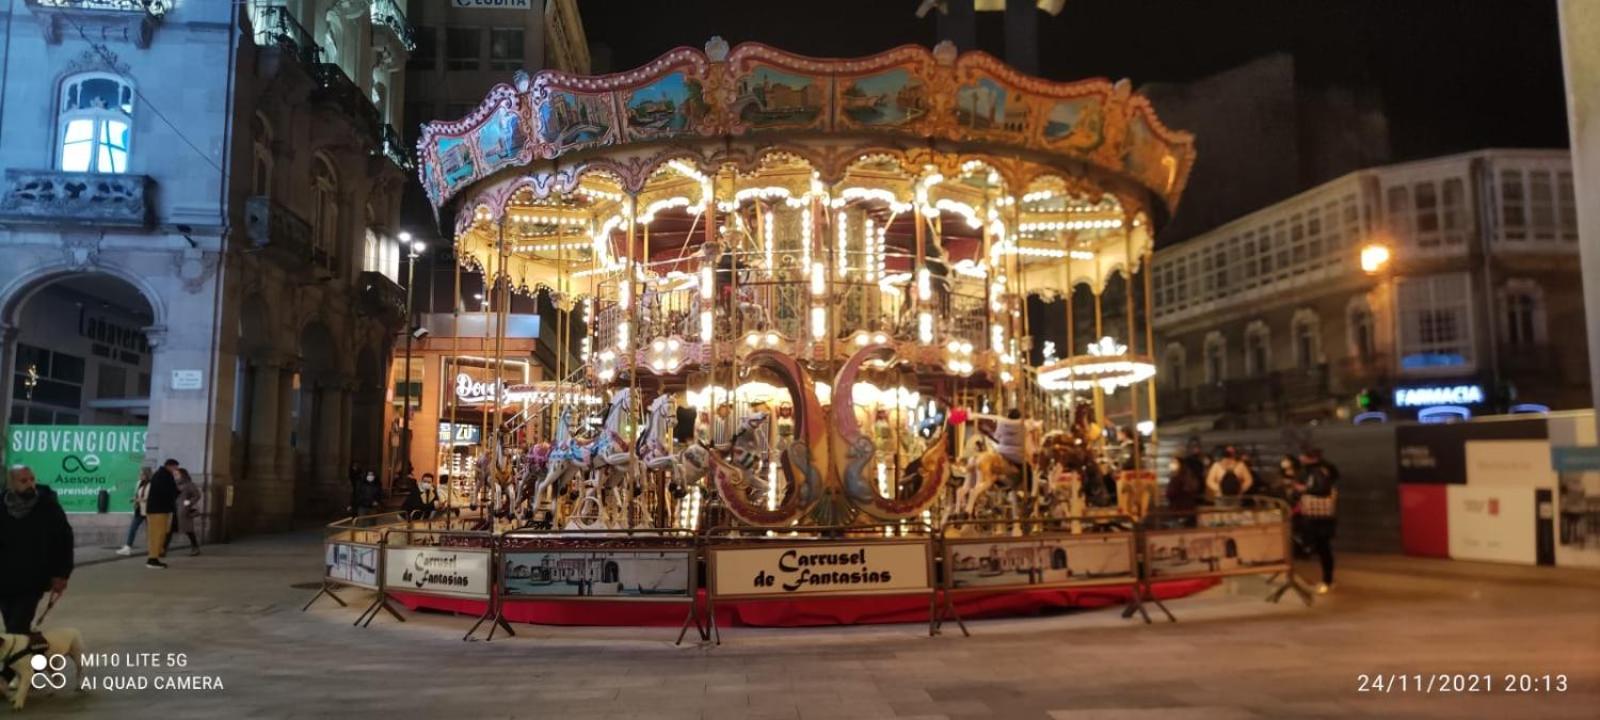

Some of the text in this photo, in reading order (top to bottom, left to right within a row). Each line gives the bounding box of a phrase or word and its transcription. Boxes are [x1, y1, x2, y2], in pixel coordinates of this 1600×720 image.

[1395, 385, 1482, 406] FARMACIA
[778, 549, 866, 572] Carrusel
[402, 568, 469, 588] de Fantasias
[754, 567, 892, 591] de Fantasias
